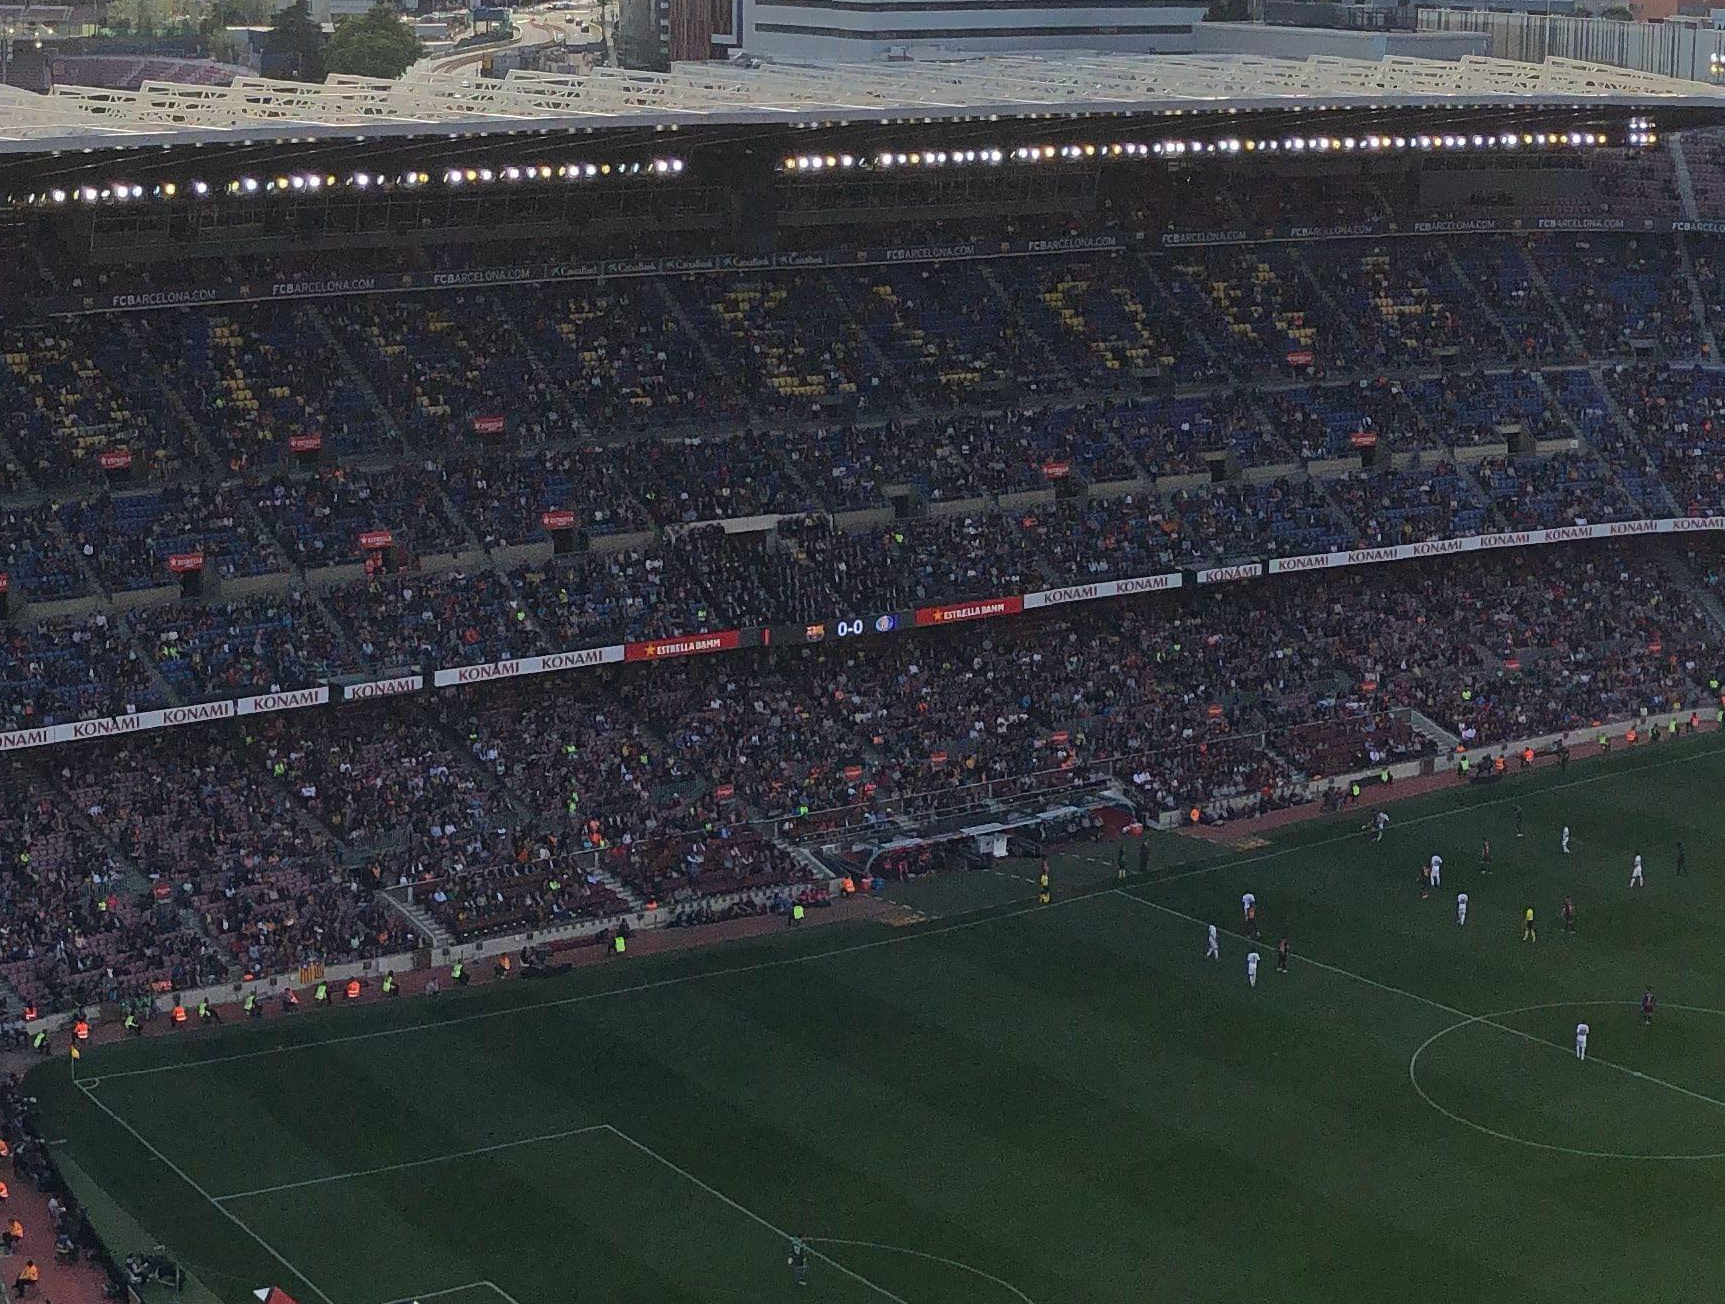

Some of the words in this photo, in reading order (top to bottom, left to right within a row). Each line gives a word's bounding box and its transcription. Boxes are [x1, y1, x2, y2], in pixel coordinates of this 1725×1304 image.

[1538, 219, 1624, 230] FCBARCELONA.COM
[1029, 236, 1116, 251] FCBARCELONA.COM
[887, 245, 974, 260] FCBARCELONA.COM
[273, 278, 375, 295] FCBARCELONA.COM
[114, 288, 217, 307] FCBARCELONA.COM
[1610, 519, 1658, 535] KONAMI
[1672, 518, 1725, 531] KONAMI
[1480, 533, 1530, 547] KONAMI
[1545, 526, 1593, 542] KONAMI
[1347, 547, 1399, 564] KONAMI
[1412, 540, 1463, 556] KONAMI
[1278, 555, 1329, 571] KONAMI
[1206, 567, 1256, 583] KONAMI
[1116, 575, 1169, 594] KONAMI
[1044, 585, 1098, 604] KONAMI
[943, 605, 980, 621] ESTRELLA
[980, 602, 1005, 616] DAMM
[838, 620, 864, 637] 0-0
[657, 640, 696, 655] ESTRELLA
[696, 637, 721, 651] DAMM
[541, 650, 603, 670] KONAMI
[459, 662, 520, 682] KONAMI
[352, 679, 416, 699] KONAMI
[254, 690, 319, 710] KONAMI
[163, 702, 229, 725] KONAMI
[73, 716, 140, 737] KONAMI
